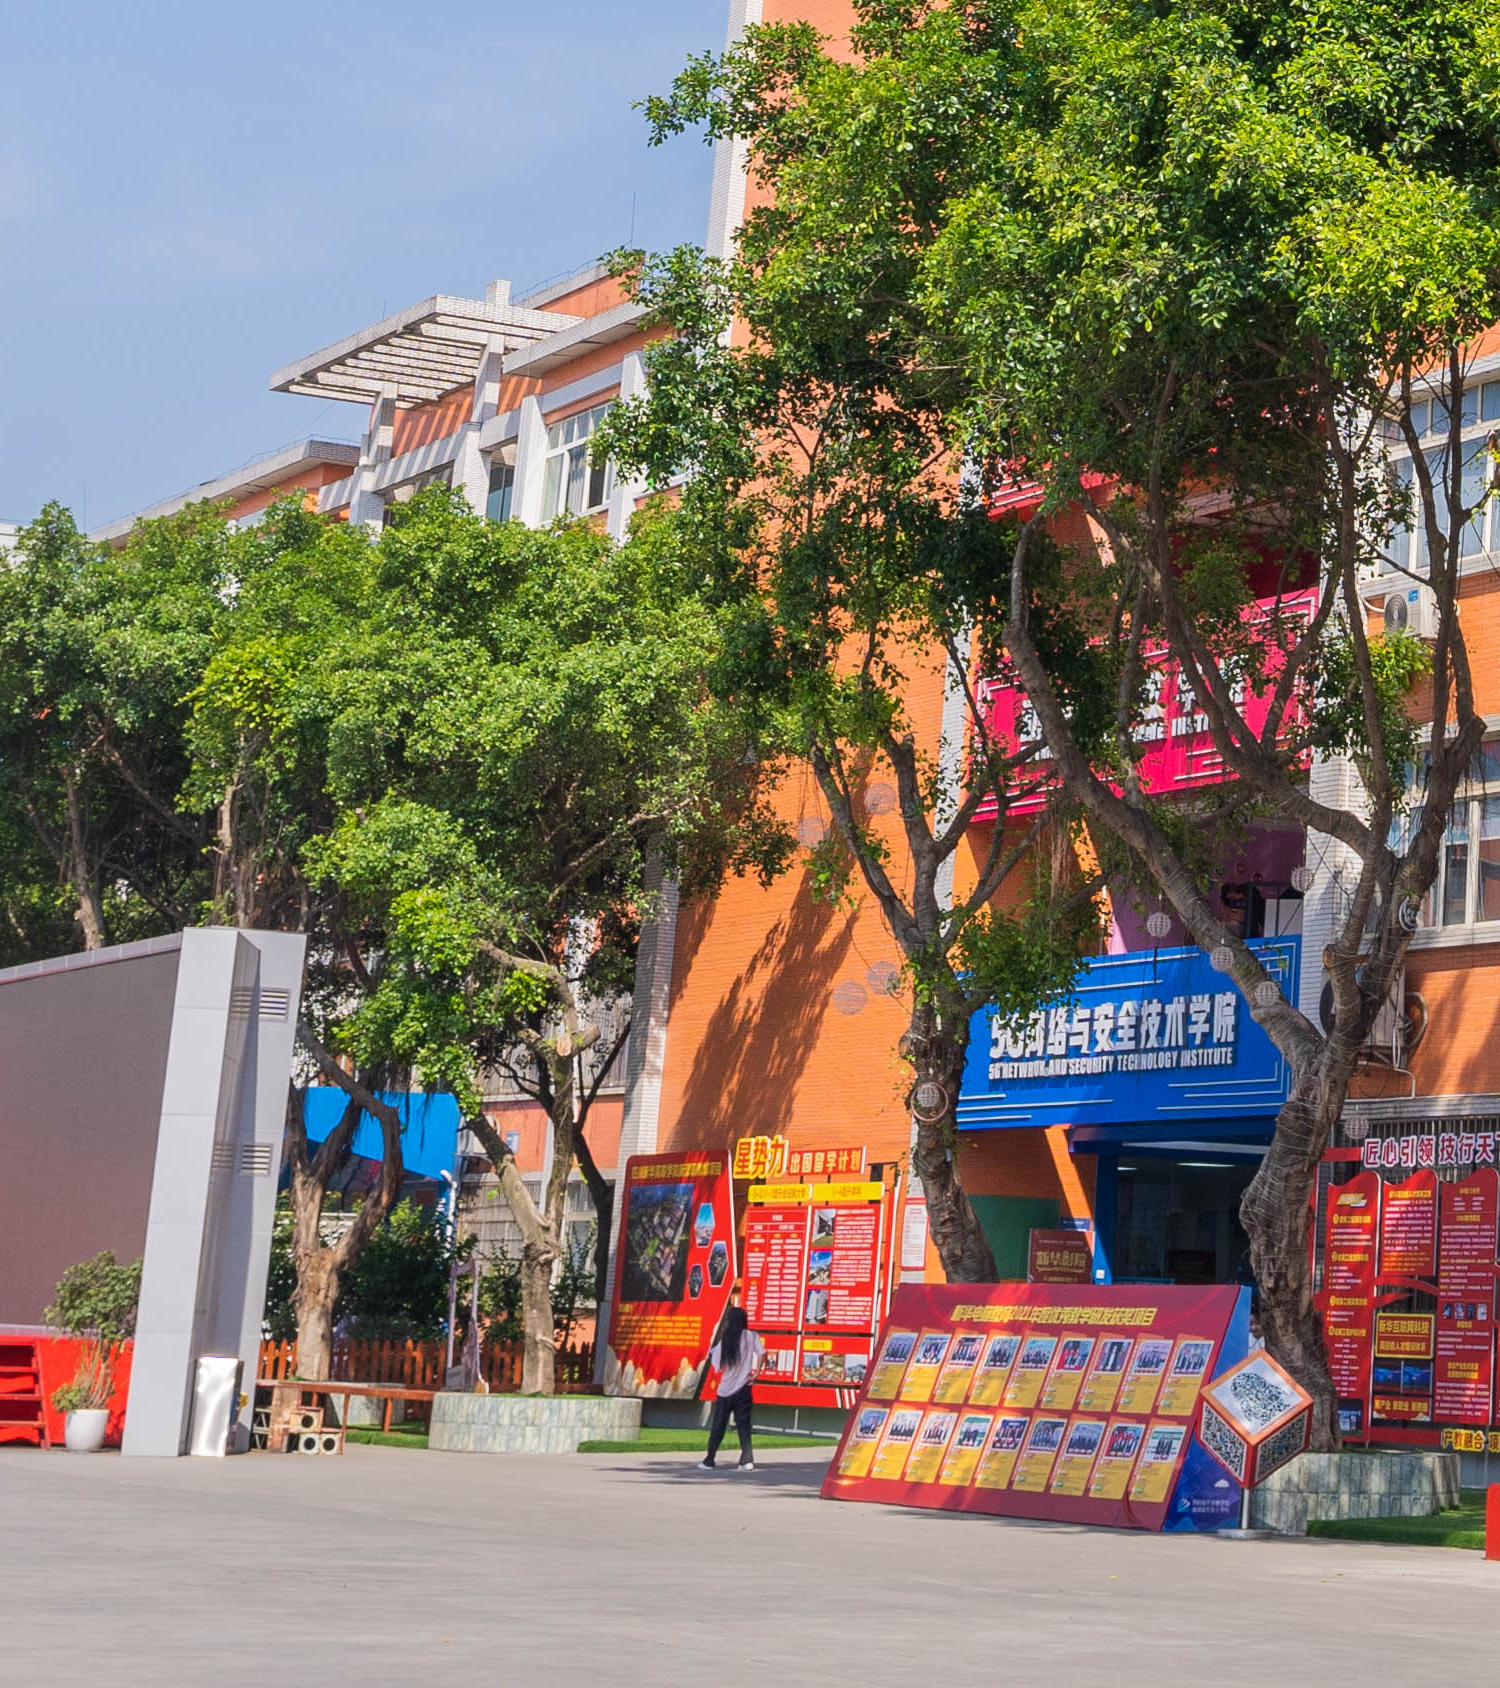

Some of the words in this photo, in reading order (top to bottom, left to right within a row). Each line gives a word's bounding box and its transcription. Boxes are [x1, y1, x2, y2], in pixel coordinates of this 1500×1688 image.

[1068, 1055, 1115, 1075] SECURITY
[1117, 1051, 1178, 1072] TECHNOLOGY
[1180, 1047, 1233, 1068] INSTITUTE
[733, 1135, 788, 1179] 星势力
[789, 1148, 863, 1173] 出国留学计划
[1362, 1135, 1434, 1168] 匠心引领
[1442, 1428, 1486, 1451] 产教融合
